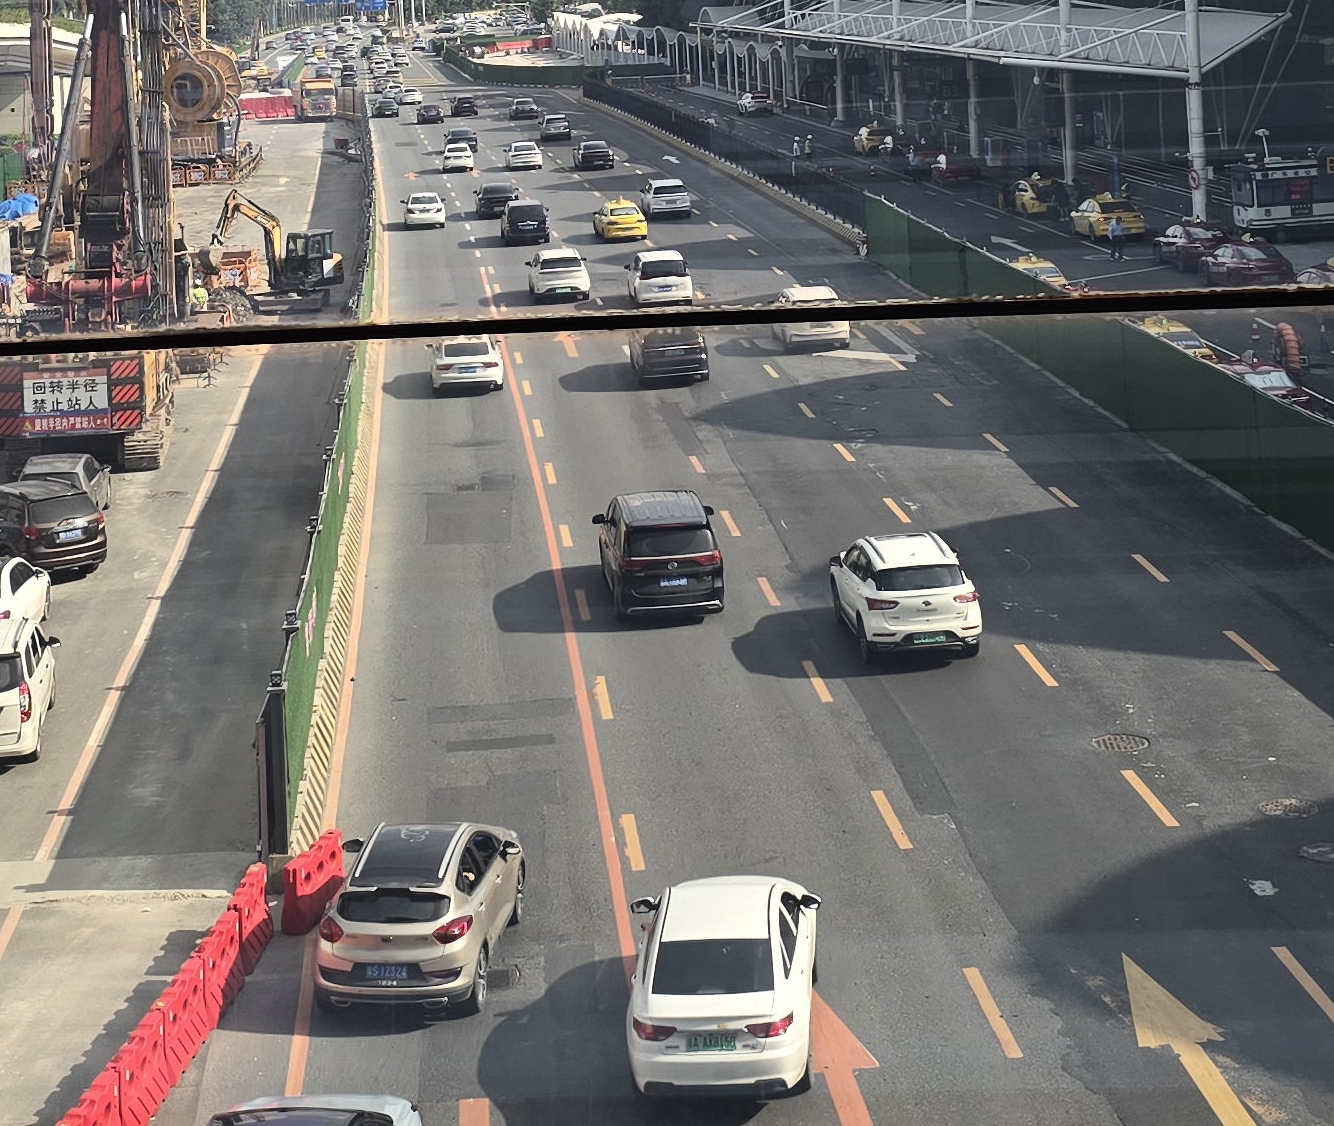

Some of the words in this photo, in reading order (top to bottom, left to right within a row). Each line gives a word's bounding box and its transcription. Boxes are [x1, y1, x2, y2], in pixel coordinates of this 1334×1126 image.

[32, 378, 99, 395] 回转半径
[32, 395, 99, 413] 禁止站人
